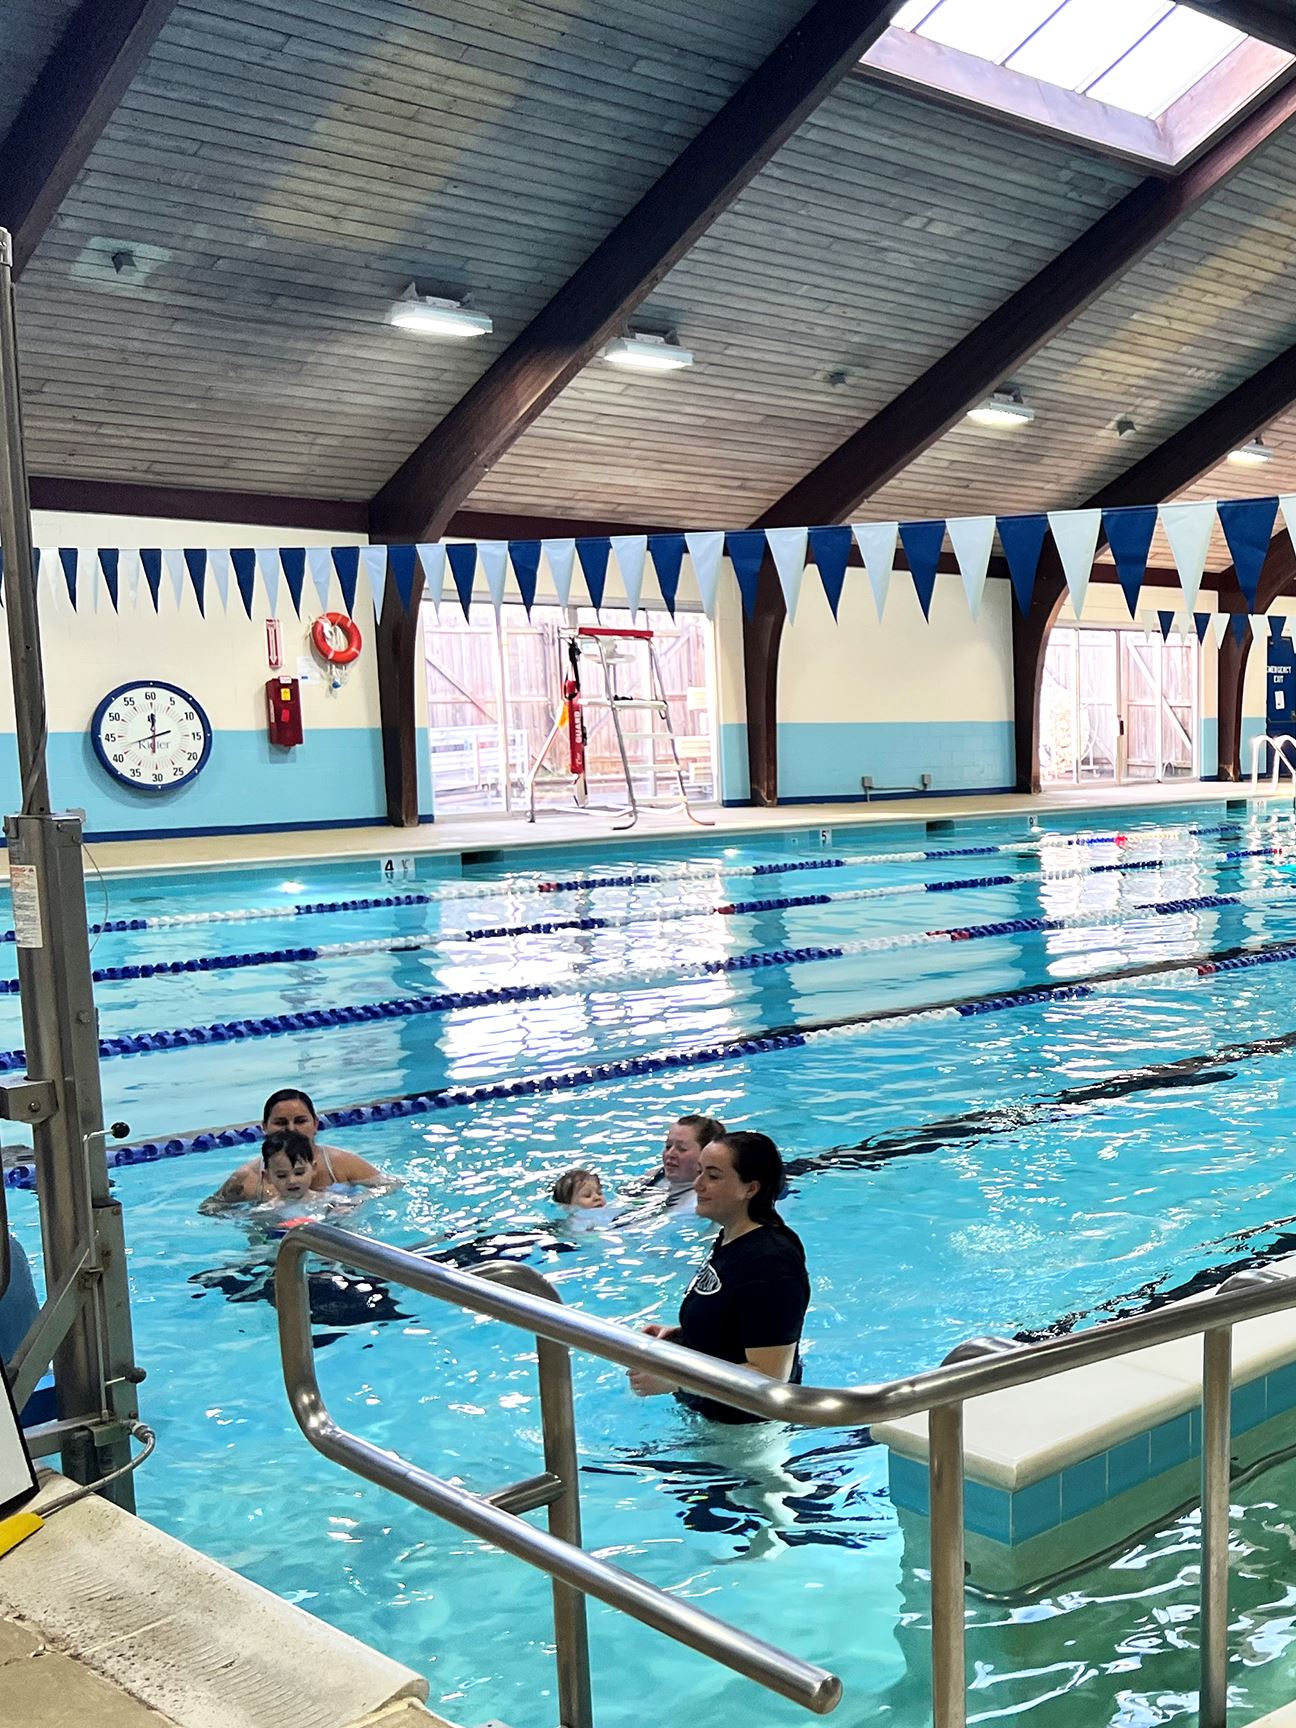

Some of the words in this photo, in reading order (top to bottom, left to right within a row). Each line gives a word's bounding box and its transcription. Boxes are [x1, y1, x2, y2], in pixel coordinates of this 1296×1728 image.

[145, 692, 156, 700] 60
[124, 697, 135, 706] 55
[170, 697, 175, 705] 5
[109, 713, 120, 721] 50
[185, 712, 194, 720] 10
[573, 710, 582, 744] GUARD
[105, 734, 116, 742] 45
[192, 732, 201, 740] 15
[113, 754, 124, 762] 40
[187, 752, 197, 760] 20
[130, 769, 141, 777] 35
[173, 767, 184, 776] 25
[152, 774, 163, 782] 30
[385, 859, 394, 871] 4
